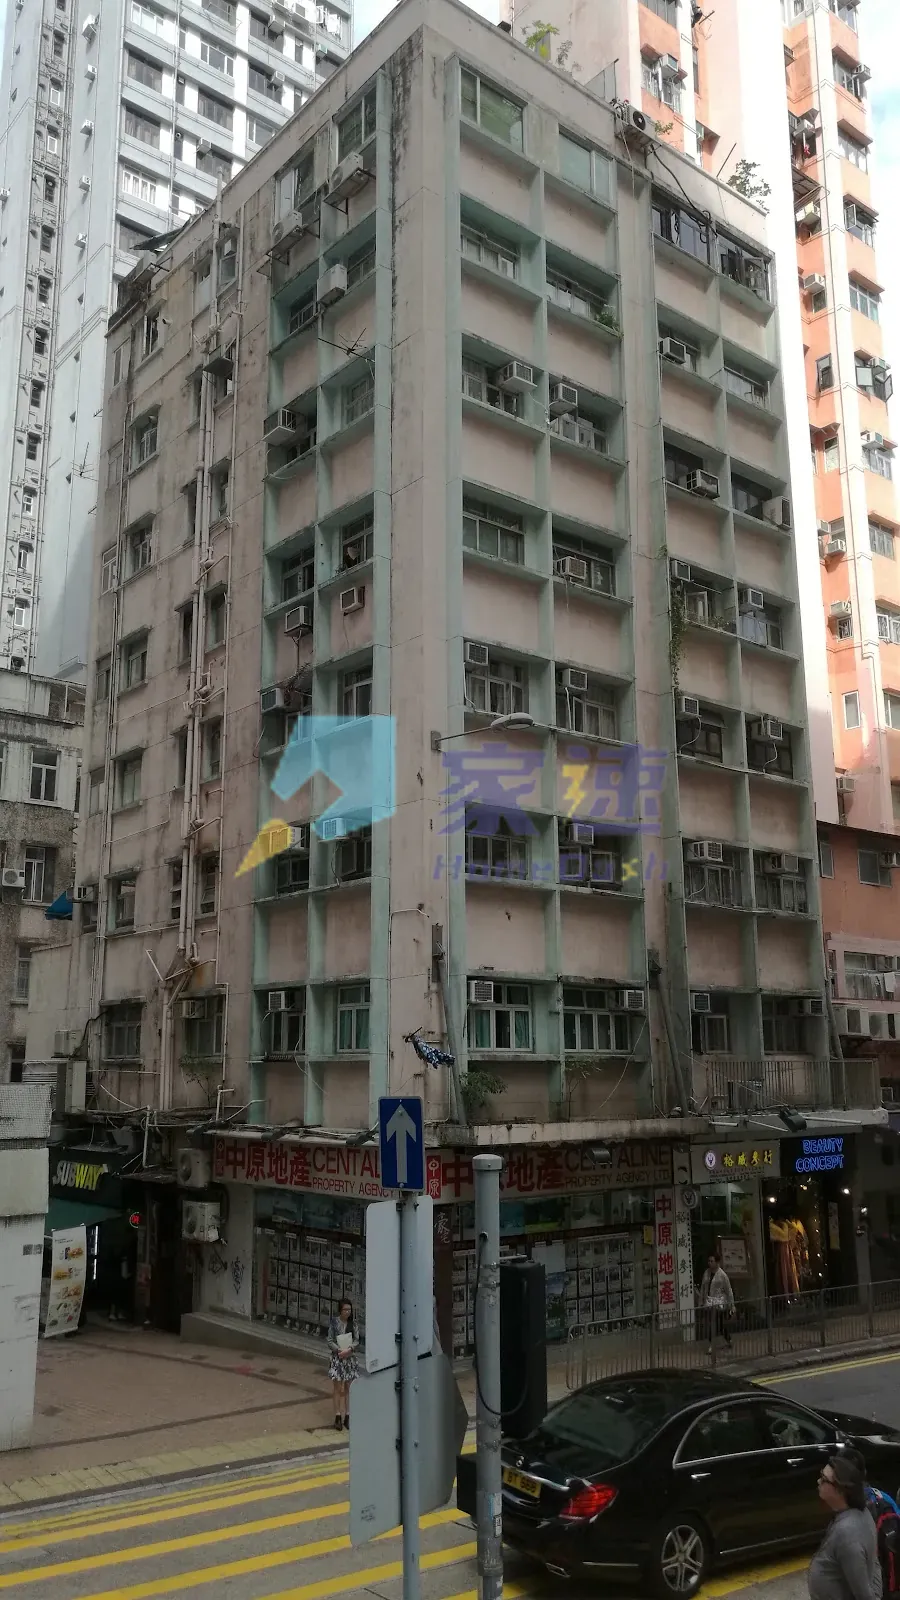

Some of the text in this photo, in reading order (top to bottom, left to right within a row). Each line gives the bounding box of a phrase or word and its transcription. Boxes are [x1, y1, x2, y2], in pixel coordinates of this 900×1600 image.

[564, 1145, 671, 1172] CEALINE
[802, 1137, 844, 1155] BEAUTY
[52, 1160, 104, 1191] SUBWAY
[226, 1139, 312, 1188] 中原地產
[312, 1146, 380, 1179] CENTAL
[442, 1150, 566, 1198] 中地產
[796, 1154, 845, 1173] CONCEPT
[312, 1176, 355, 1195] PROPERTY
[565, 1174, 612, 1188] PROPERTY
[616, 1171, 650, 1184] AGENCY
[656, 1194, 675, 1305] 中原地產
